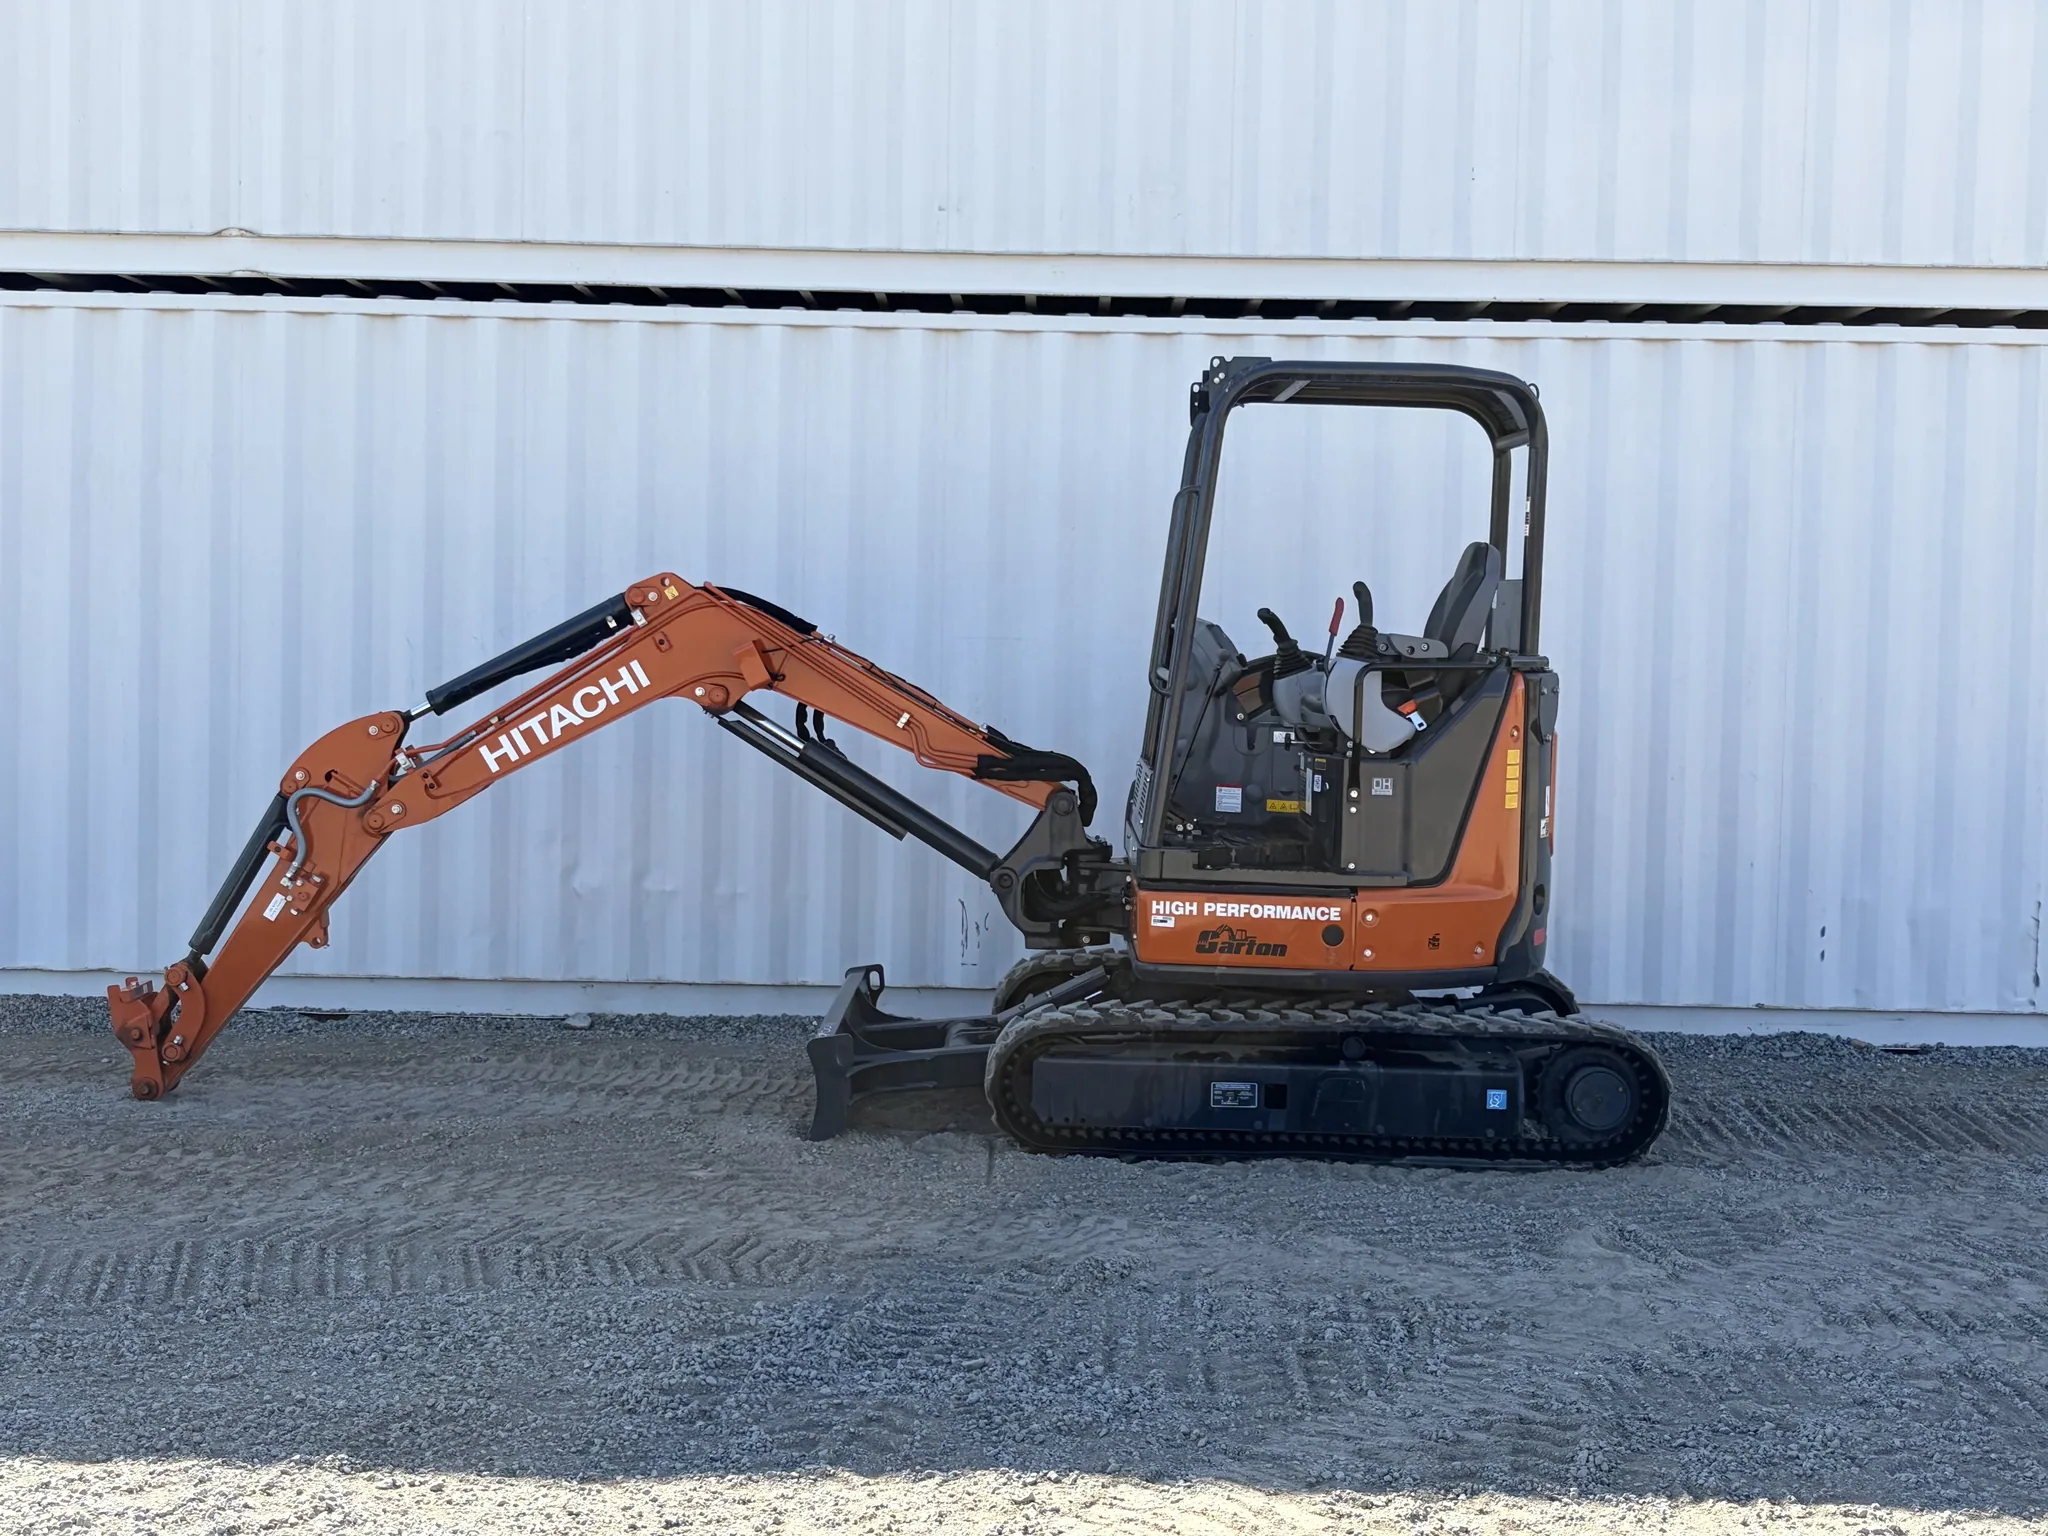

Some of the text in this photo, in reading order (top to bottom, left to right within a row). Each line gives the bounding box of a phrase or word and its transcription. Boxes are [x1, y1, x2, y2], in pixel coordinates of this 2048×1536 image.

[478, 659, 651, 773] HITACHI
[1152, 901, 1342, 921] HIGH PERFORMANCE
